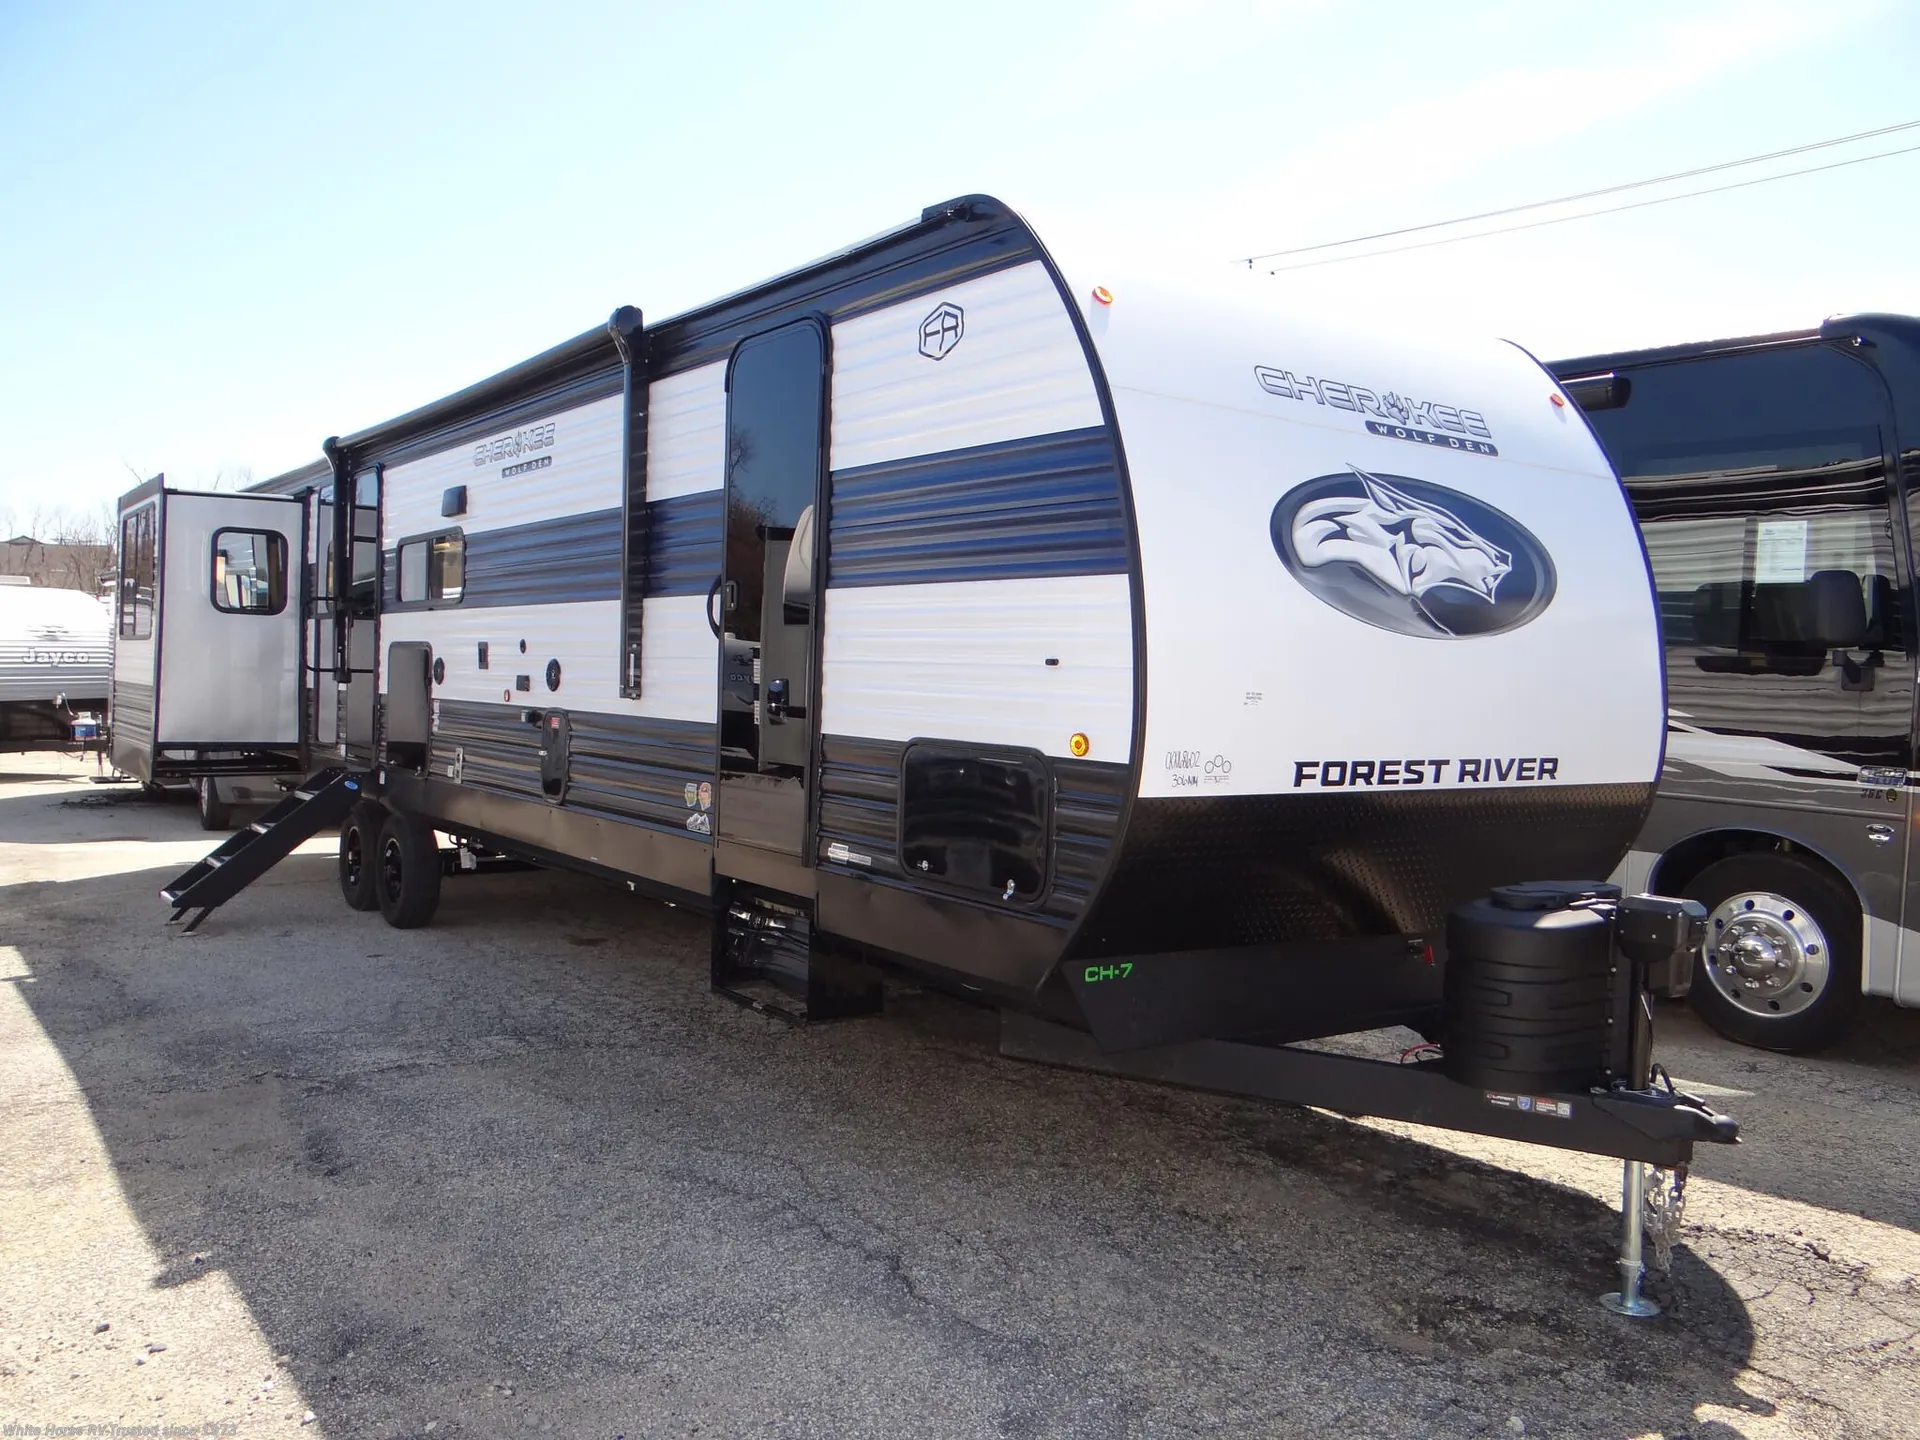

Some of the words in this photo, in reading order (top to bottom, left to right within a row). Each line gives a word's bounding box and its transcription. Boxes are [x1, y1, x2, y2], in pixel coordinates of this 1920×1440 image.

[1374, 423, 1436, 444] WOLF
[1448, 438, 1491, 454] DEN
[505, 463, 527, 475] WOLF
[531, 457, 549, 469] DEN
[22, 646, 90, 668] Jayco
[1292, 759, 1451, 788] FOREST
[1457, 757, 1560, 784] RIVER
[1084, 962, 1133, 982] CH-7
